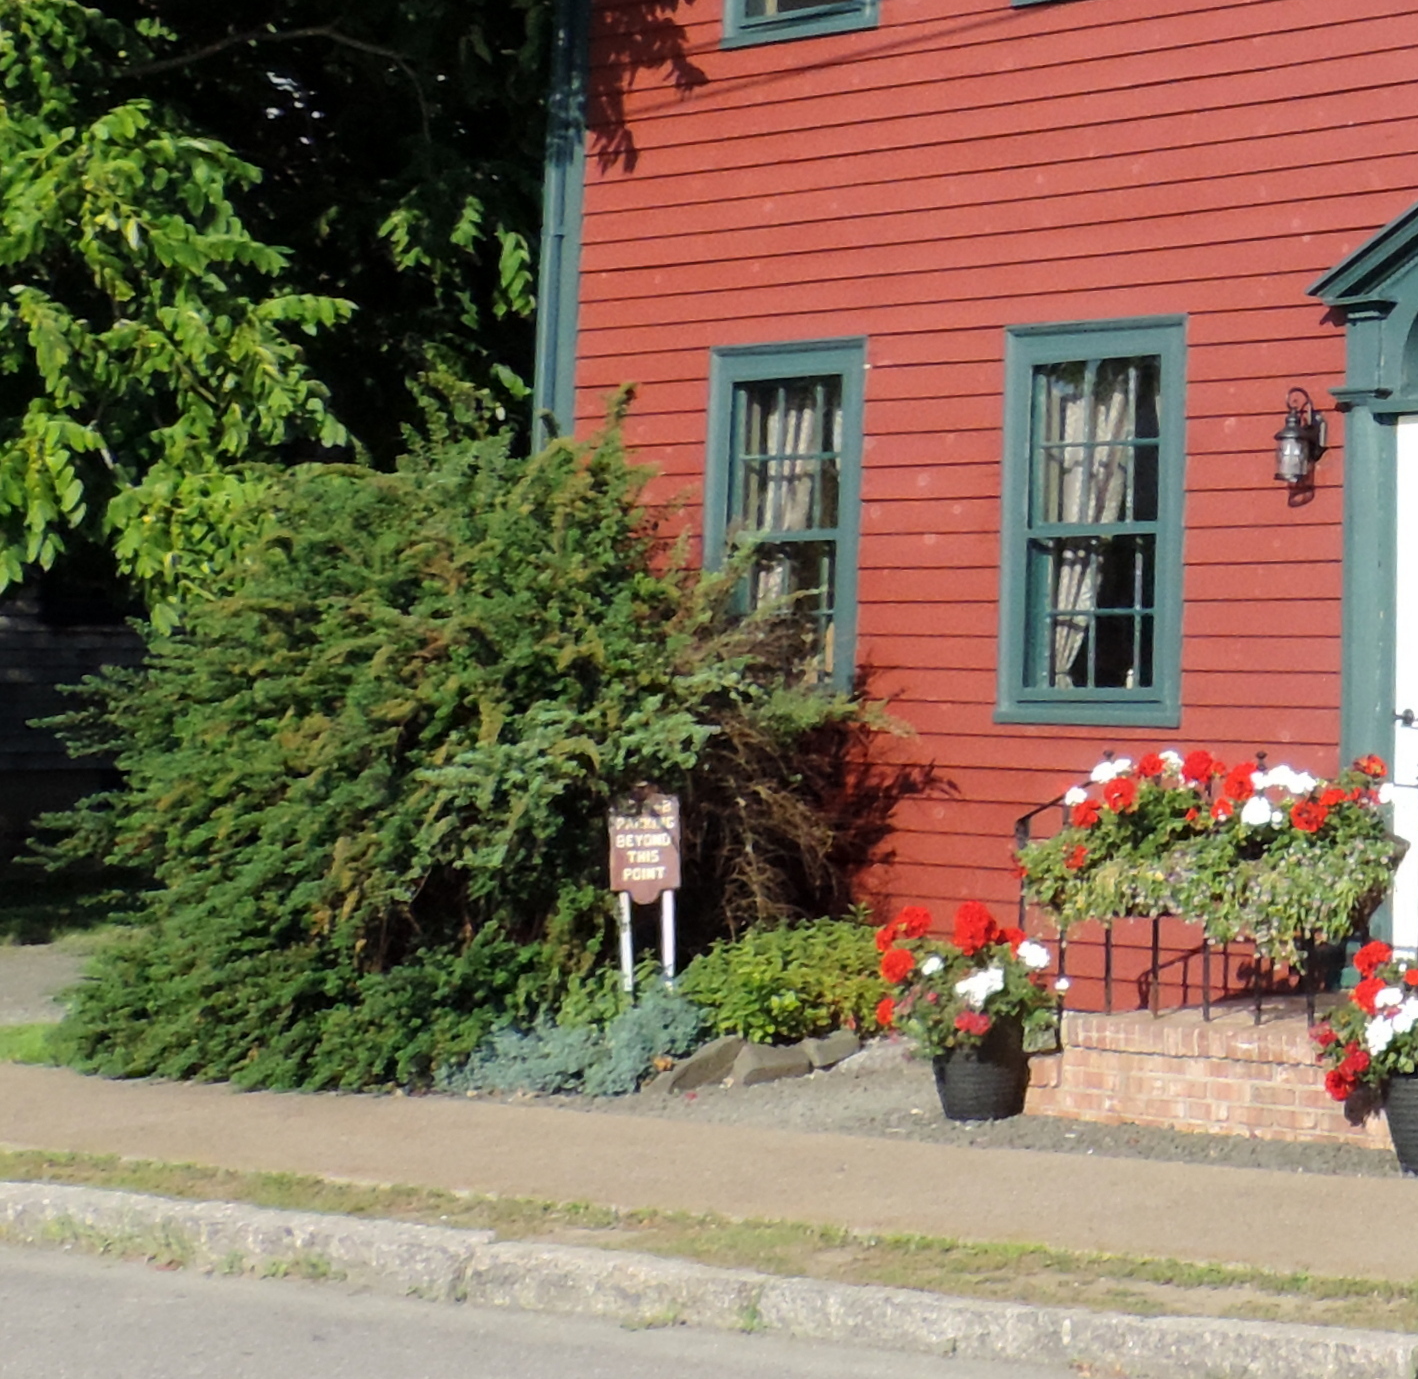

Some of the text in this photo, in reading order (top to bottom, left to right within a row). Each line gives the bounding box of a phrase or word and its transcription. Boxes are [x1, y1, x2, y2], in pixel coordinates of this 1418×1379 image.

[616, 833, 671, 848] BEYOND
[626, 850, 660, 863] THIS
[622, 867, 666, 881] POINT
